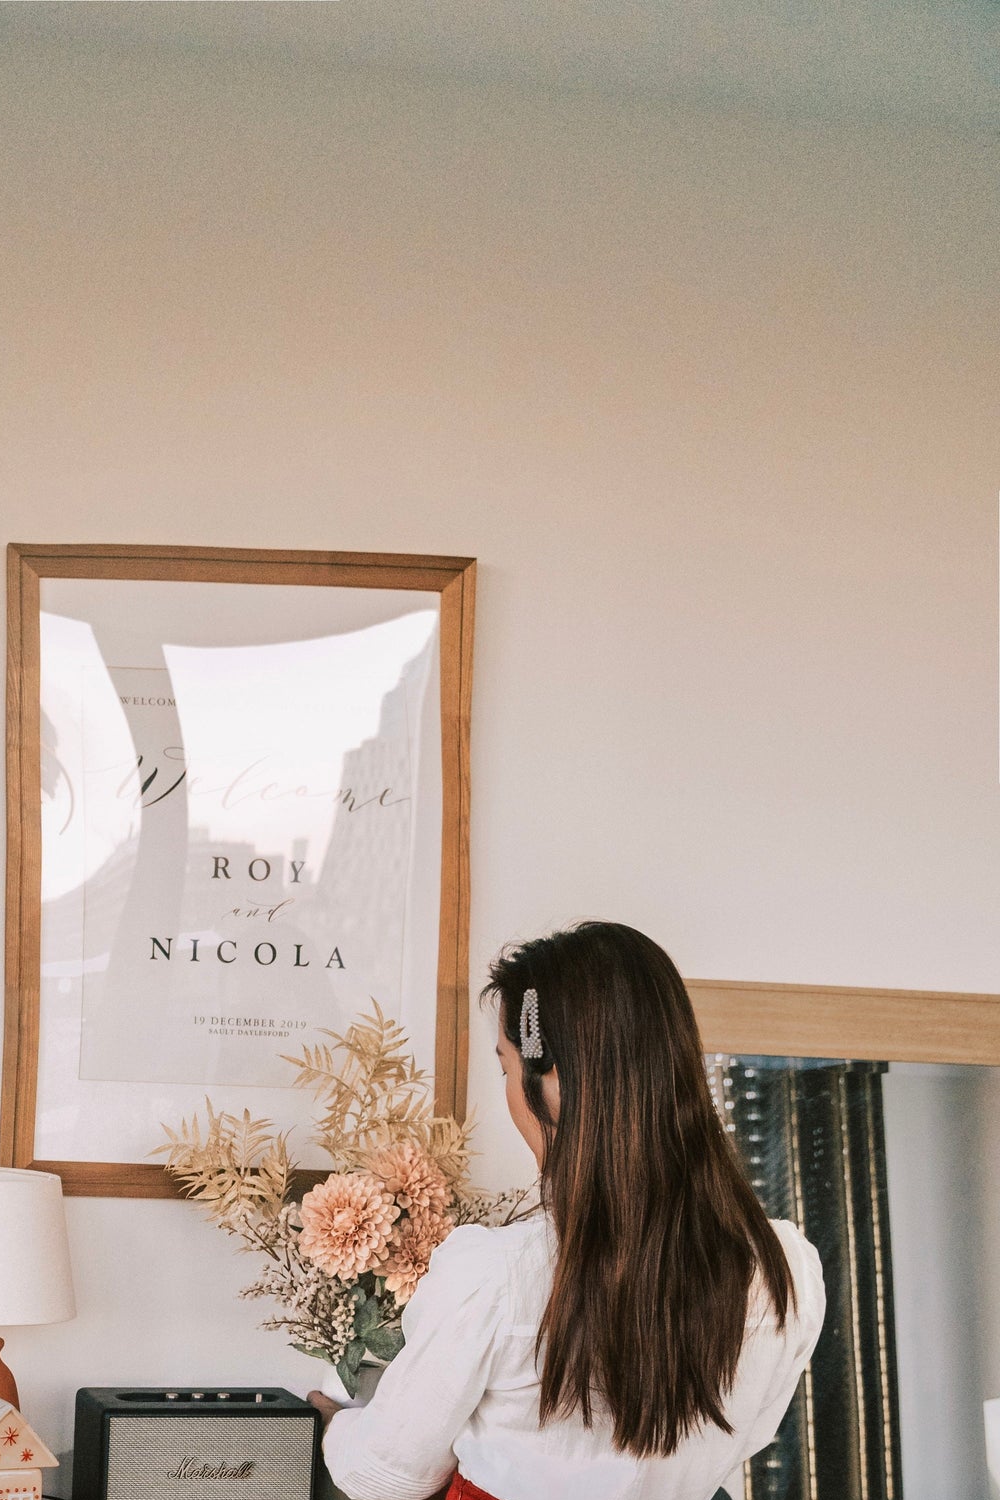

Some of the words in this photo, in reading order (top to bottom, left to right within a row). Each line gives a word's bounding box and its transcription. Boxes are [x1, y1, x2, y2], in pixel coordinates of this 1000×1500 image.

[119, 696, 177, 707] WELCOM
[85, 746, 412, 813] Welcome
[211, 856, 306, 884] ROY
[221, 898, 295, 923] and
[149, 936, 347, 970] NICOLA
[193, 1015, 206, 1026] 19
[210, 1016, 276, 1028] DECEMBER
[280, 1019, 308, 1030] 2019
[208, 1028, 235, 1036] SAULT
[237, 1029, 290, 1038] DAYLESFORD
[167, 1455, 255, 1480] Marshall
